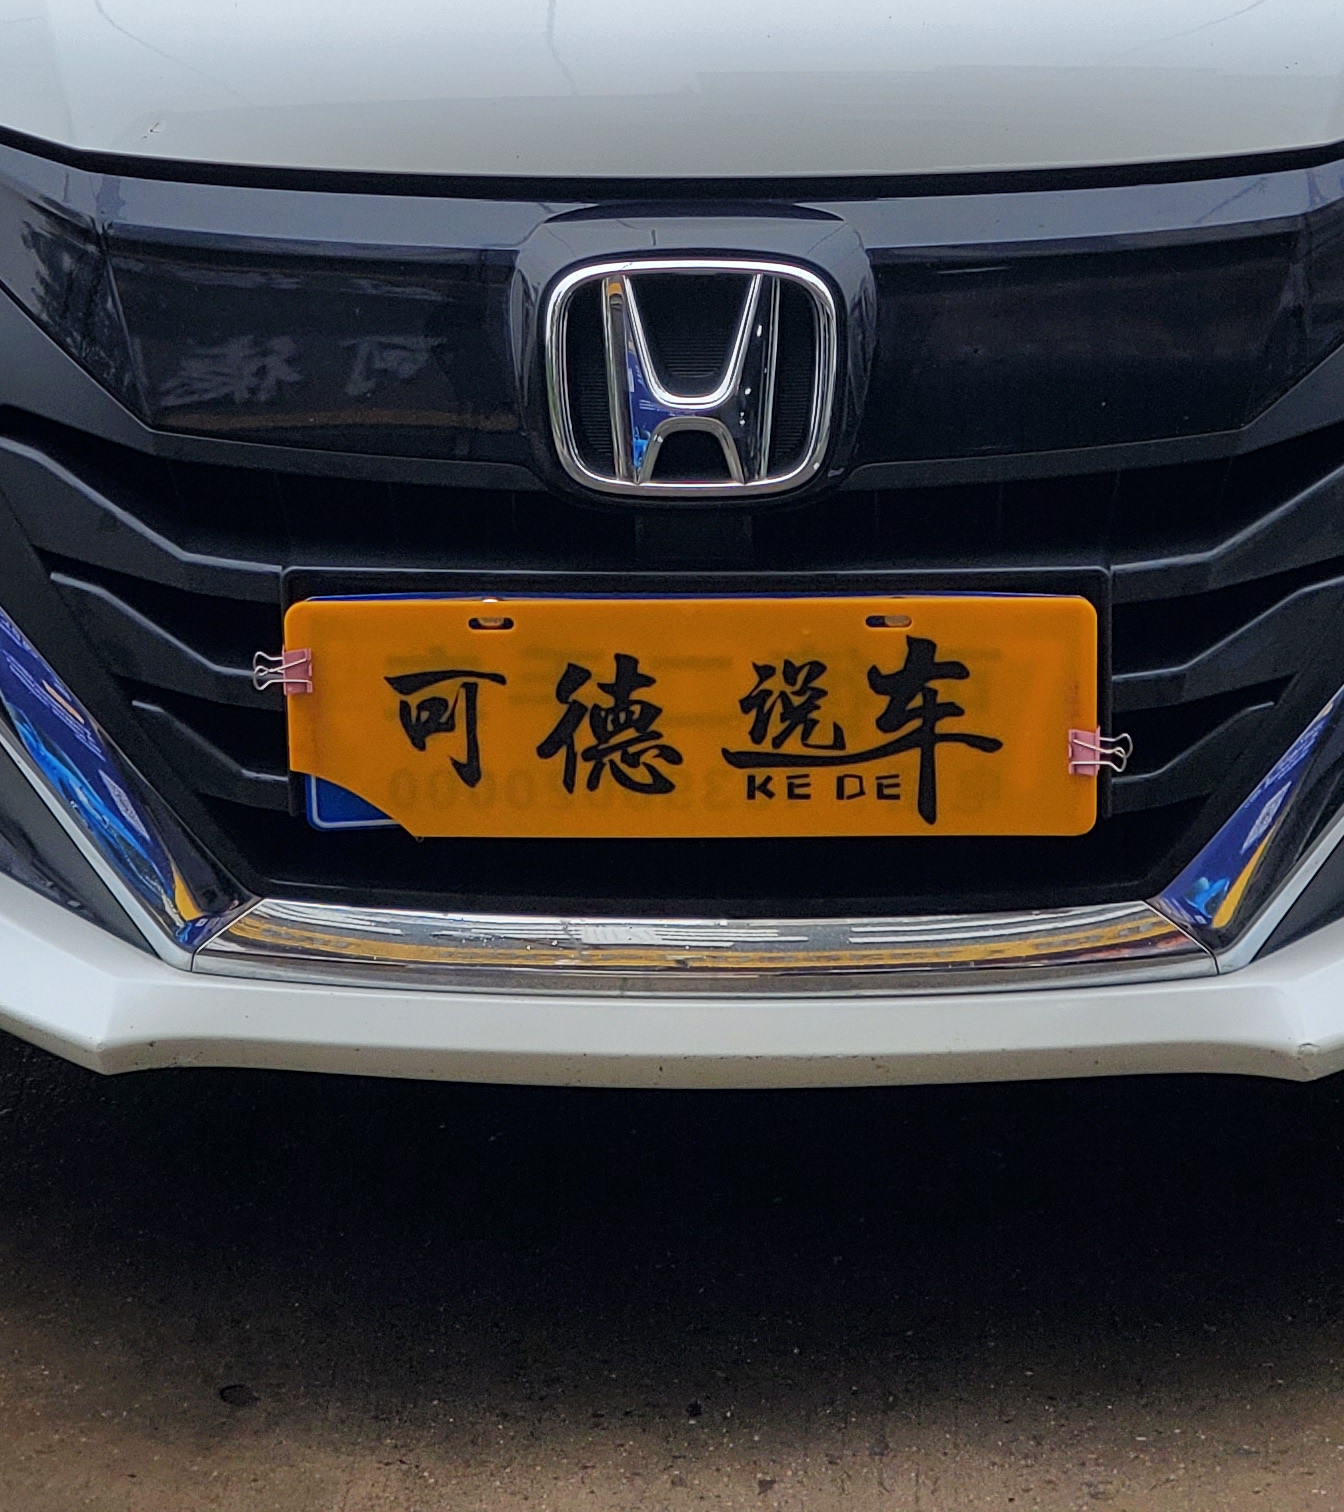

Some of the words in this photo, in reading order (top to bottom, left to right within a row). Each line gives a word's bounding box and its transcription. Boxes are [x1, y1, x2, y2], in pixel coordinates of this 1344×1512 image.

[384, 635, 1003, 825] 可德说车
[747, 773, 811, 800] KE
[836, 773, 901, 800] DE
